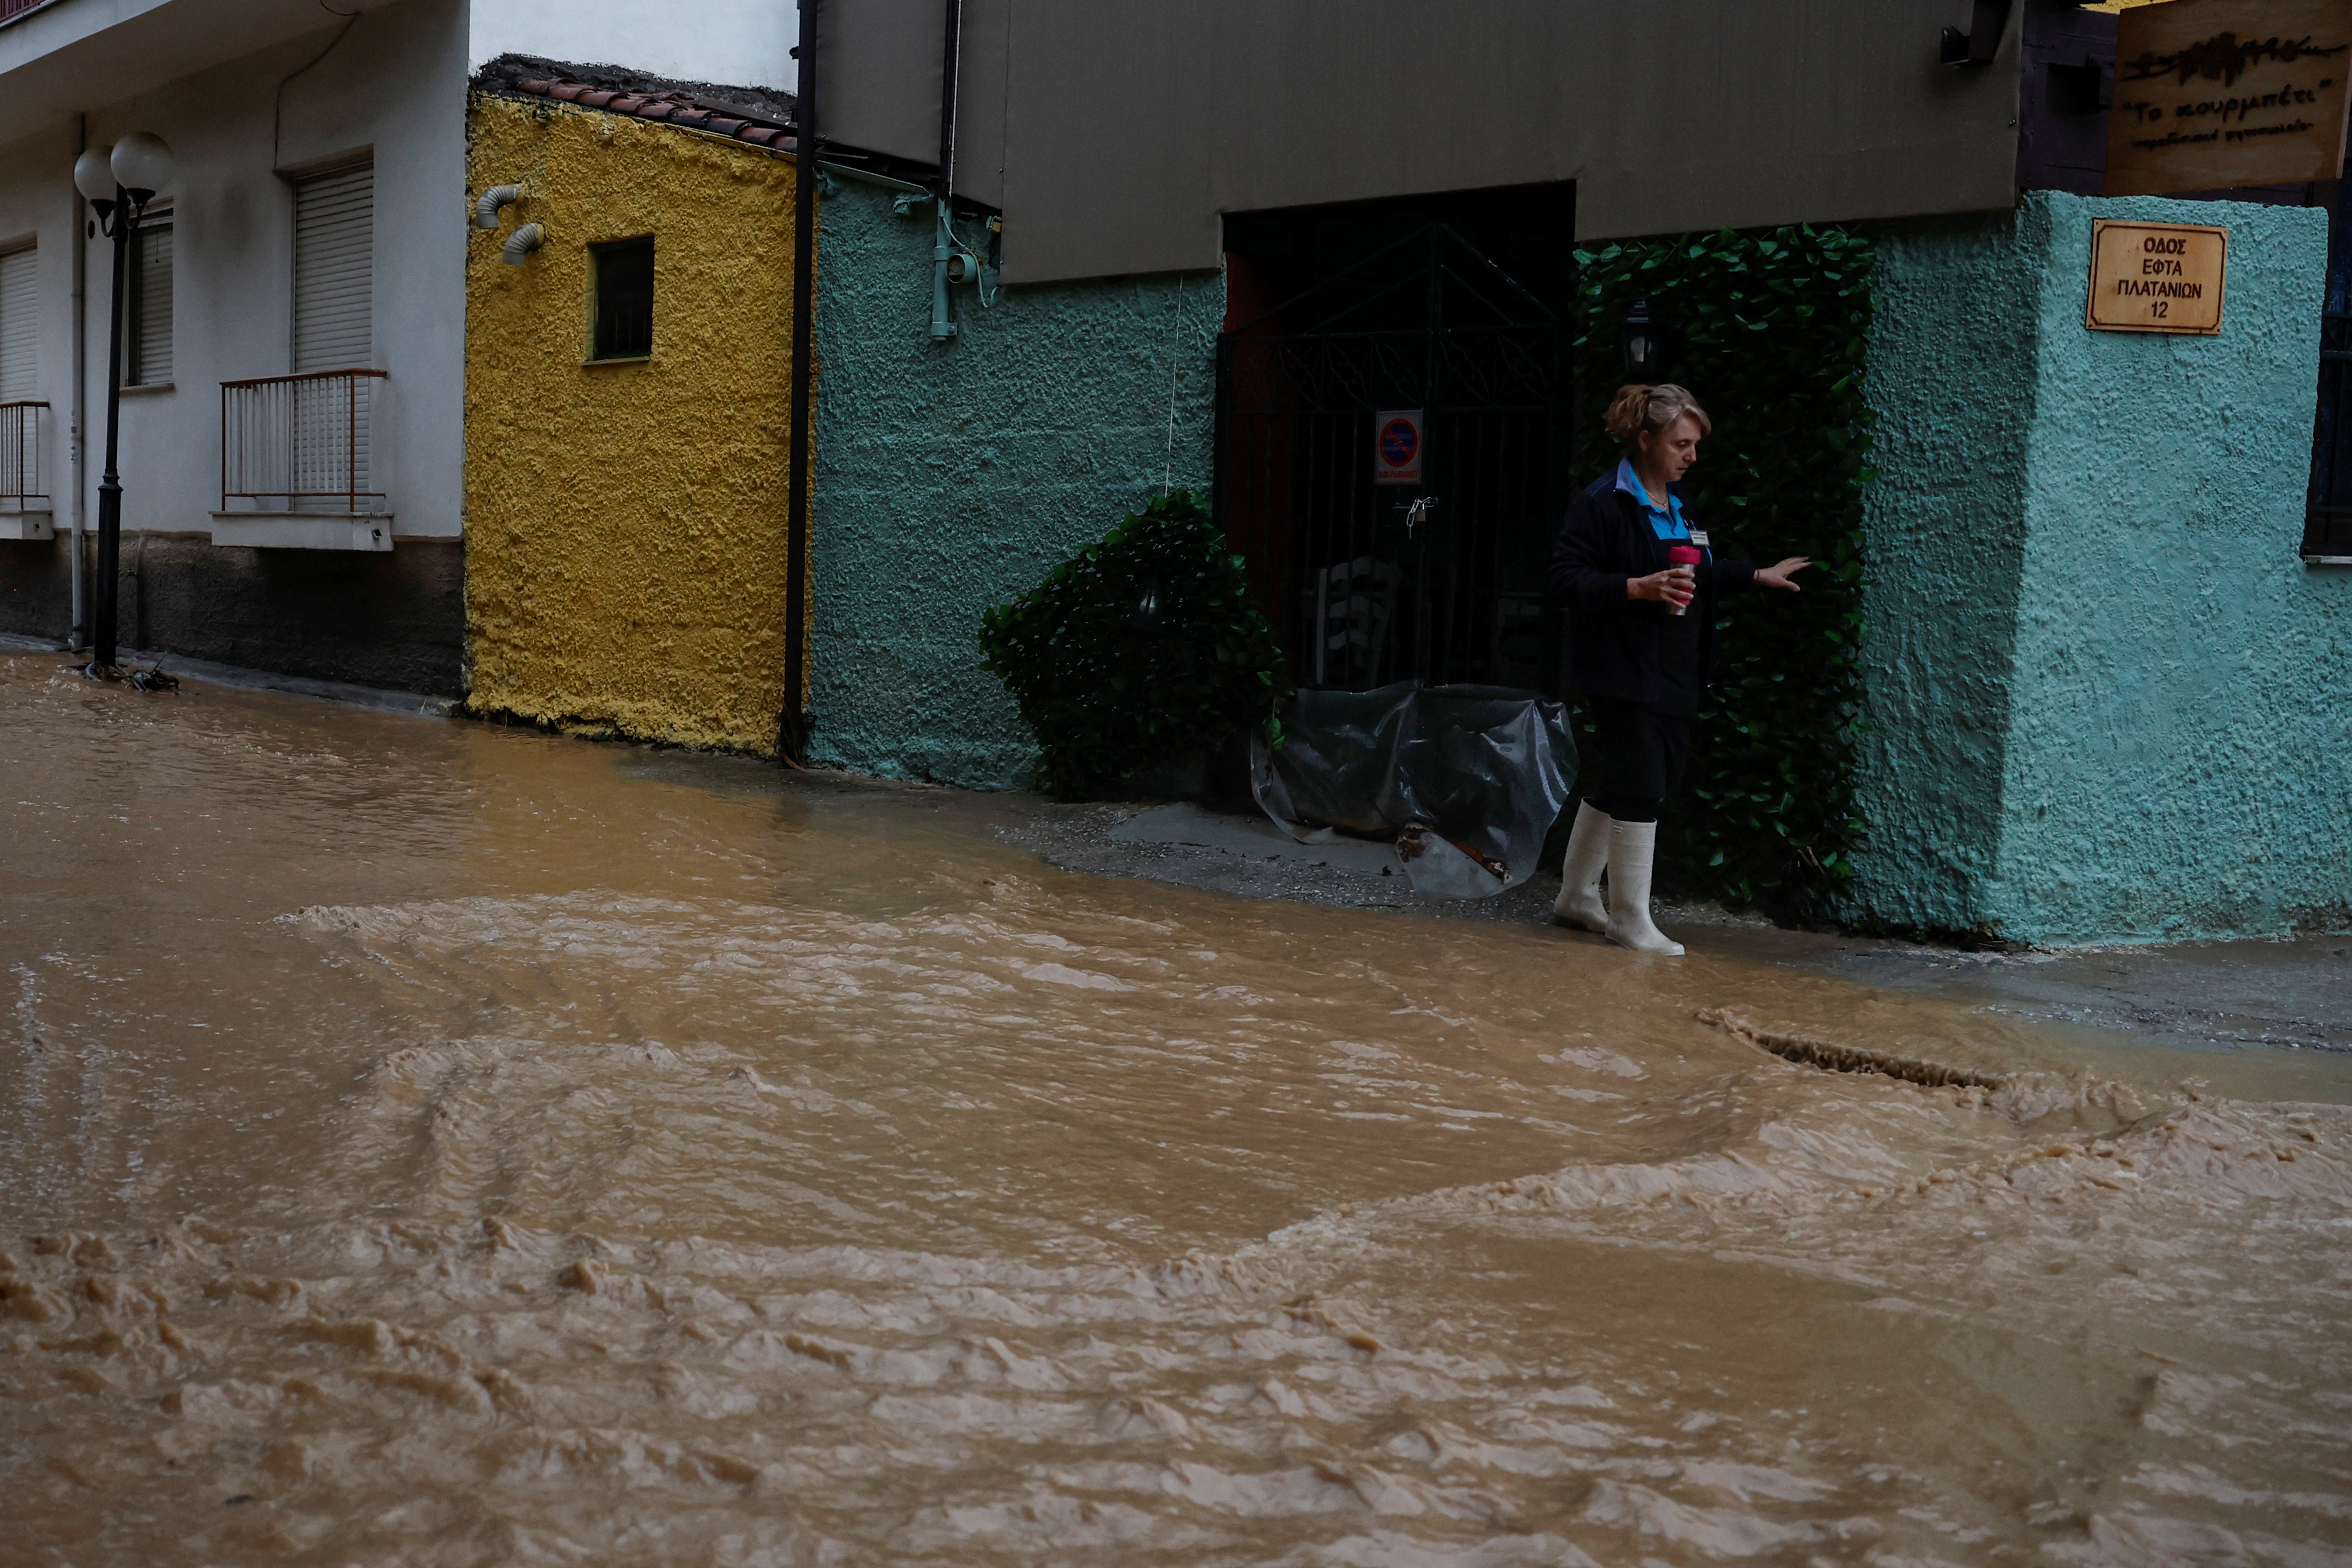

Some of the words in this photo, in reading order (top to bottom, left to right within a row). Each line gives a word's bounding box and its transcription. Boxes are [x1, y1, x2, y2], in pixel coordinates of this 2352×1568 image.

[2144, 237, 2186, 254] ΟΔΟΣ
[2143, 259, 2182, 276] ΕΦΤΑ
[2118, 279, 2202, 298] ΠΛΑΤΑΝΙΩΝ
[2151, 301, 2168, 318] 12
[1378, 470, 1389, 479] NO
